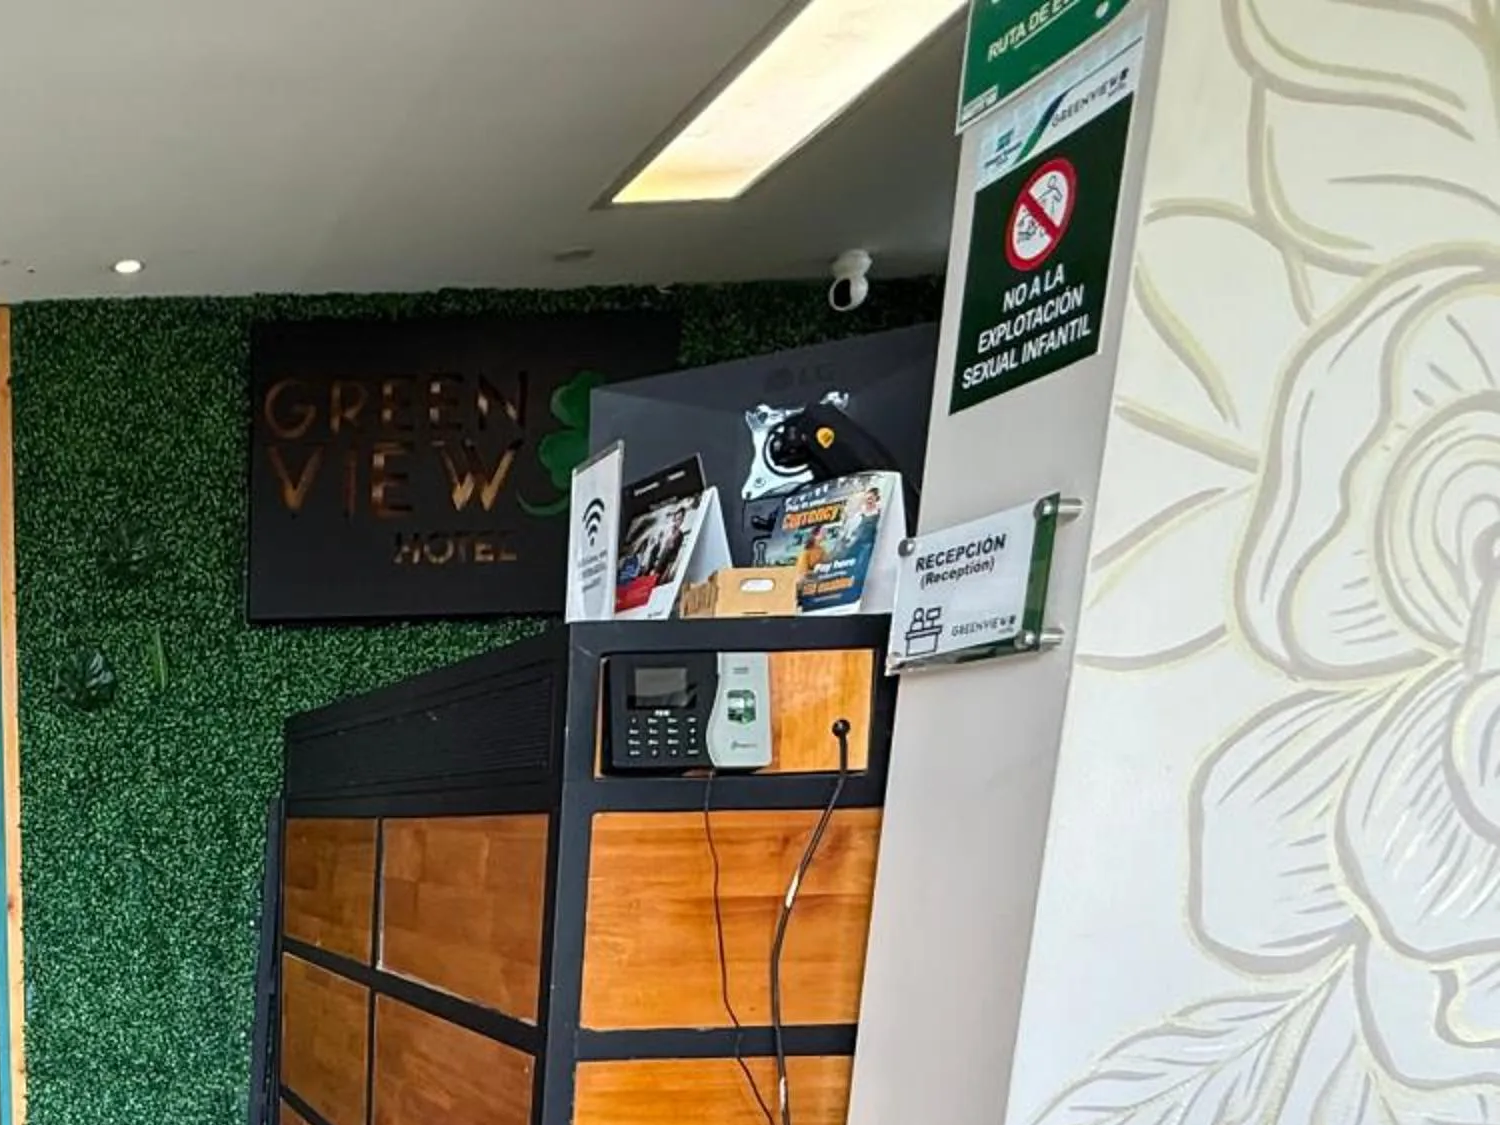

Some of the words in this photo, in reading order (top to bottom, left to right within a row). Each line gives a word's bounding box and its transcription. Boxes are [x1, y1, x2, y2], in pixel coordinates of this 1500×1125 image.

[987, 22, 1026, 62] RUTA
[1028, 2, 1051, 31] DE
[977, 283, 1085, 353] EXPLOTACIÓN
[1003, 288, 1026, 312] NO
[1029, 279, 1042, 298] A
[1043, 263, 1065, 292] LA
[961, 352, 1019, 389] SEXUAL
[1020, 314, 1092, 365] INFANTIL
[264, 371, 529, 439] GREEN
[267, 438, 525, 519] VIEW
[394, 531, 517, 564] HOTEL
[915, 533, 1007, 573] RECEPCIÓN
